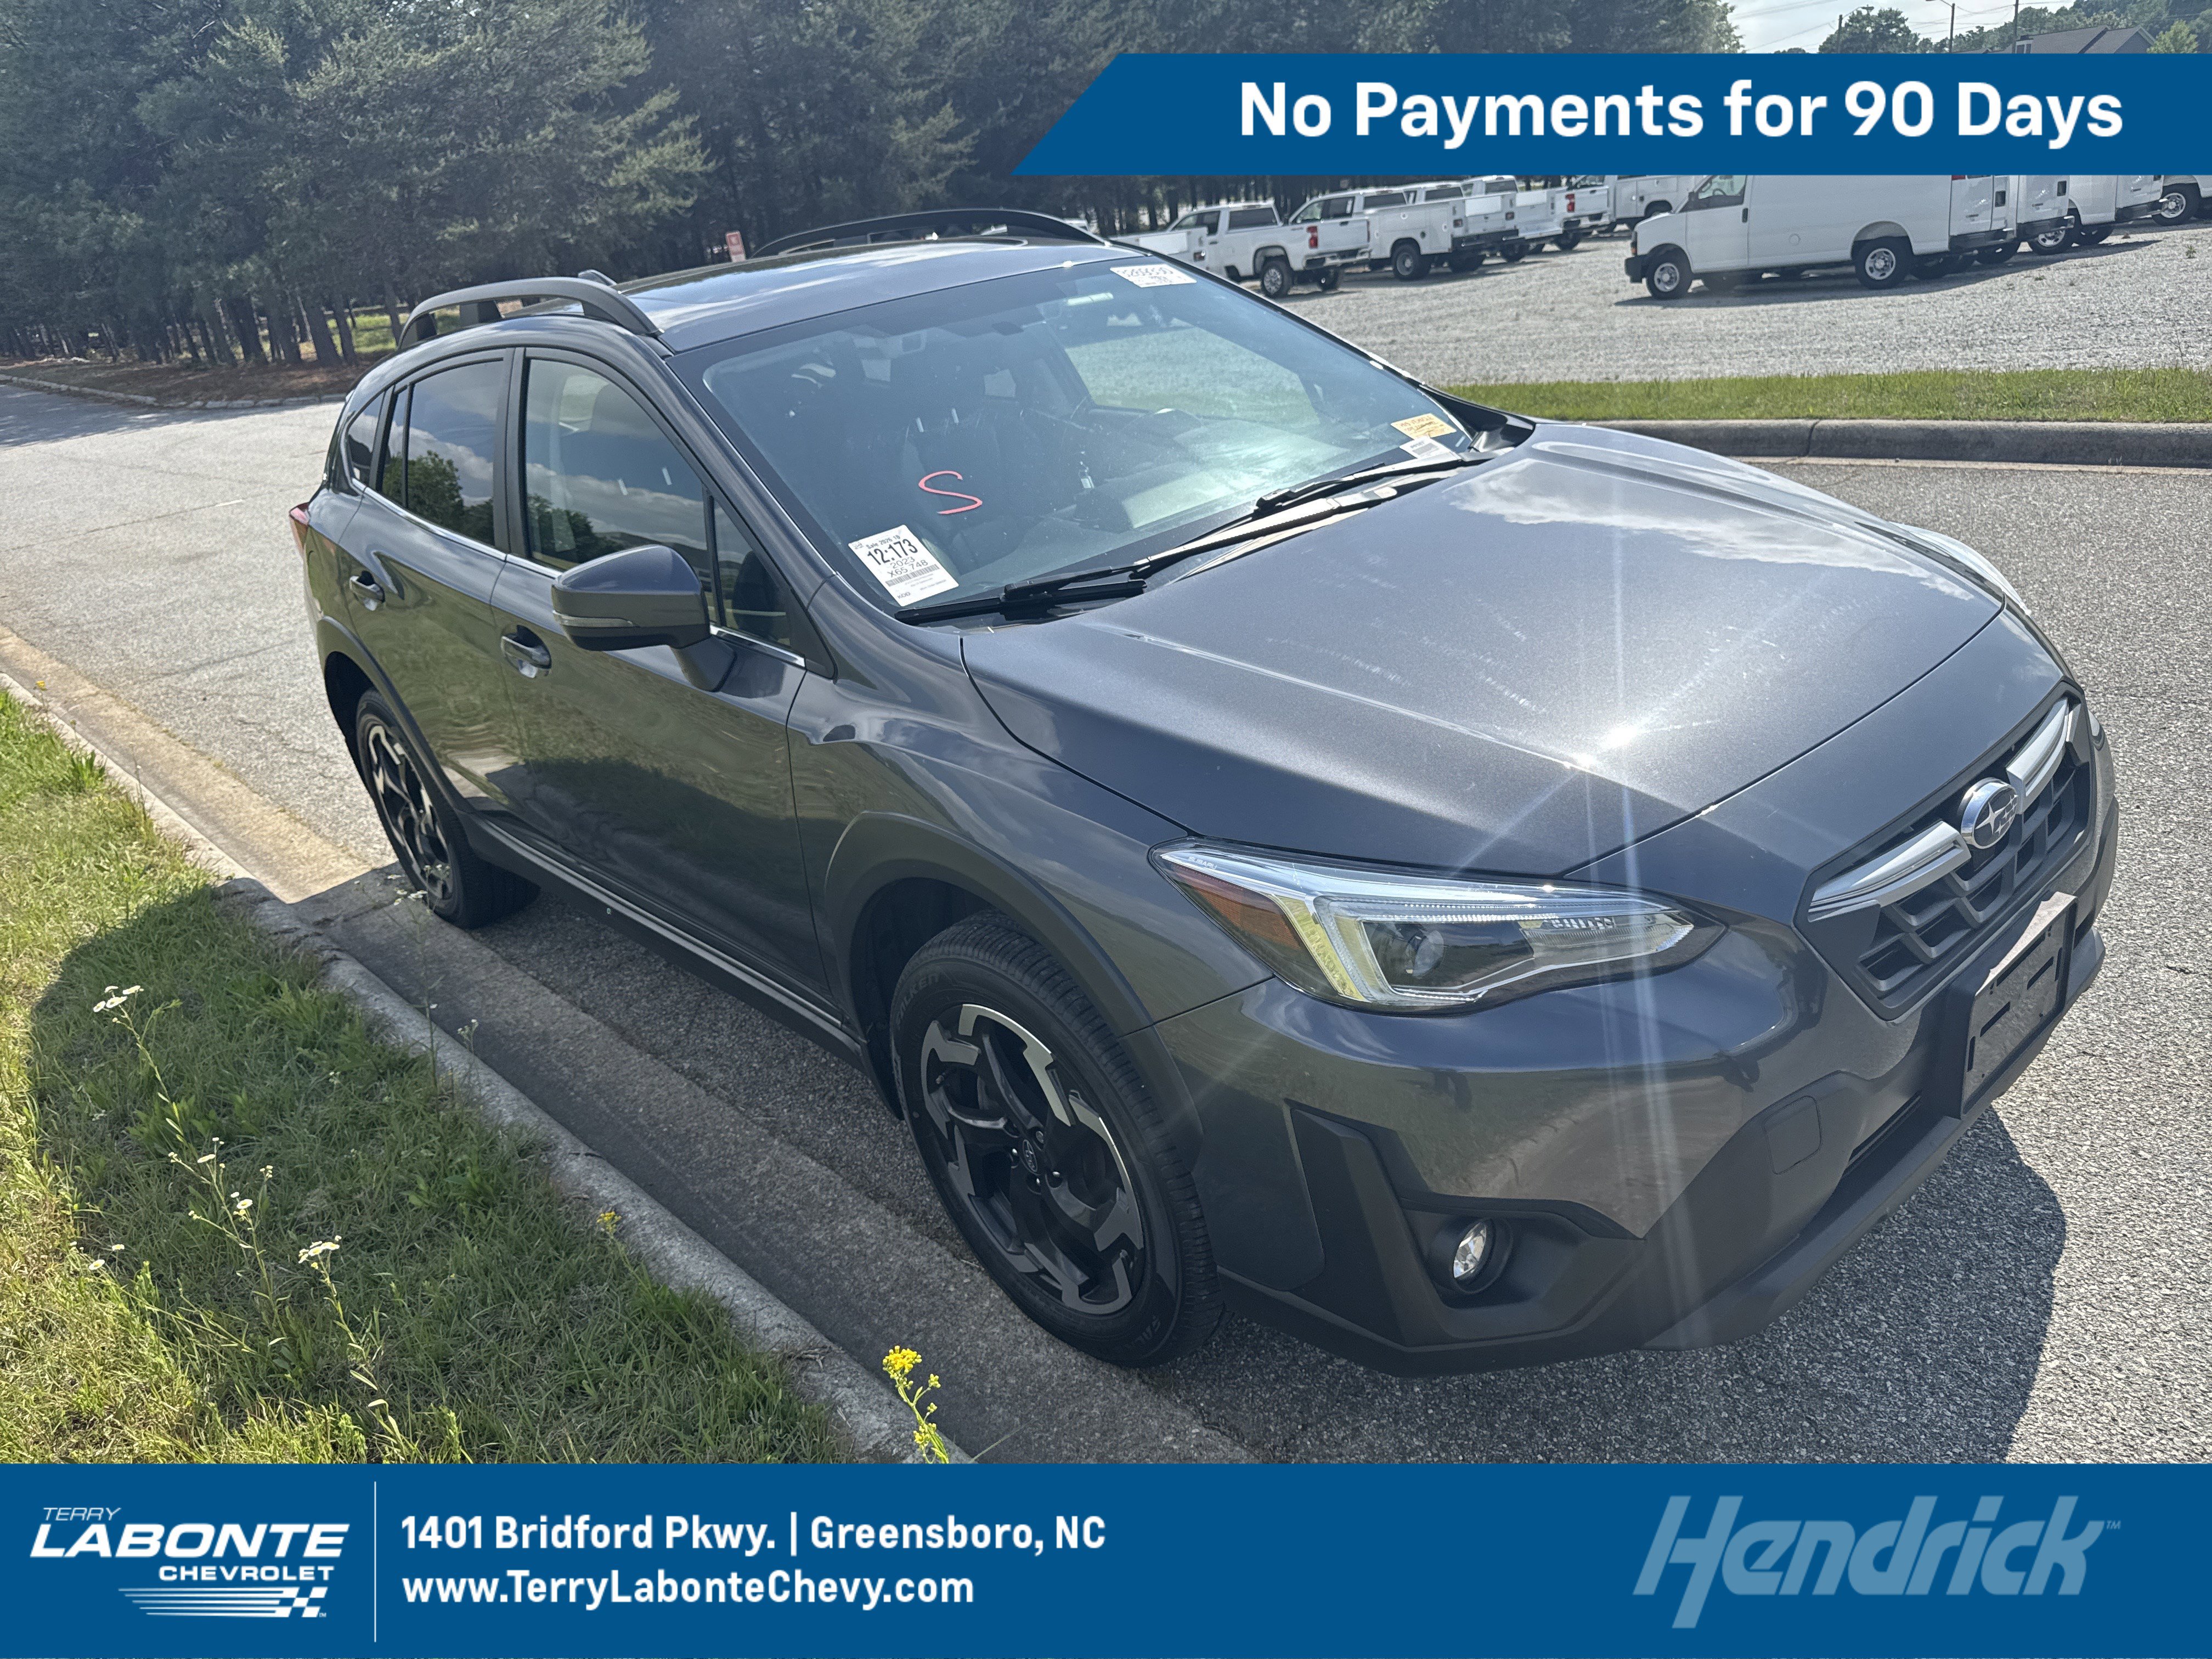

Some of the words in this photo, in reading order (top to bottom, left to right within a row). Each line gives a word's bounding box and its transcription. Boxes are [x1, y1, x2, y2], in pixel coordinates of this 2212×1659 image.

[918, 470, 983, 515] S
[867, 538, 918, 566] 12:173
[890, 556, 915, 569] 2023
[1188, 856, 1217, 870] SUBARU
